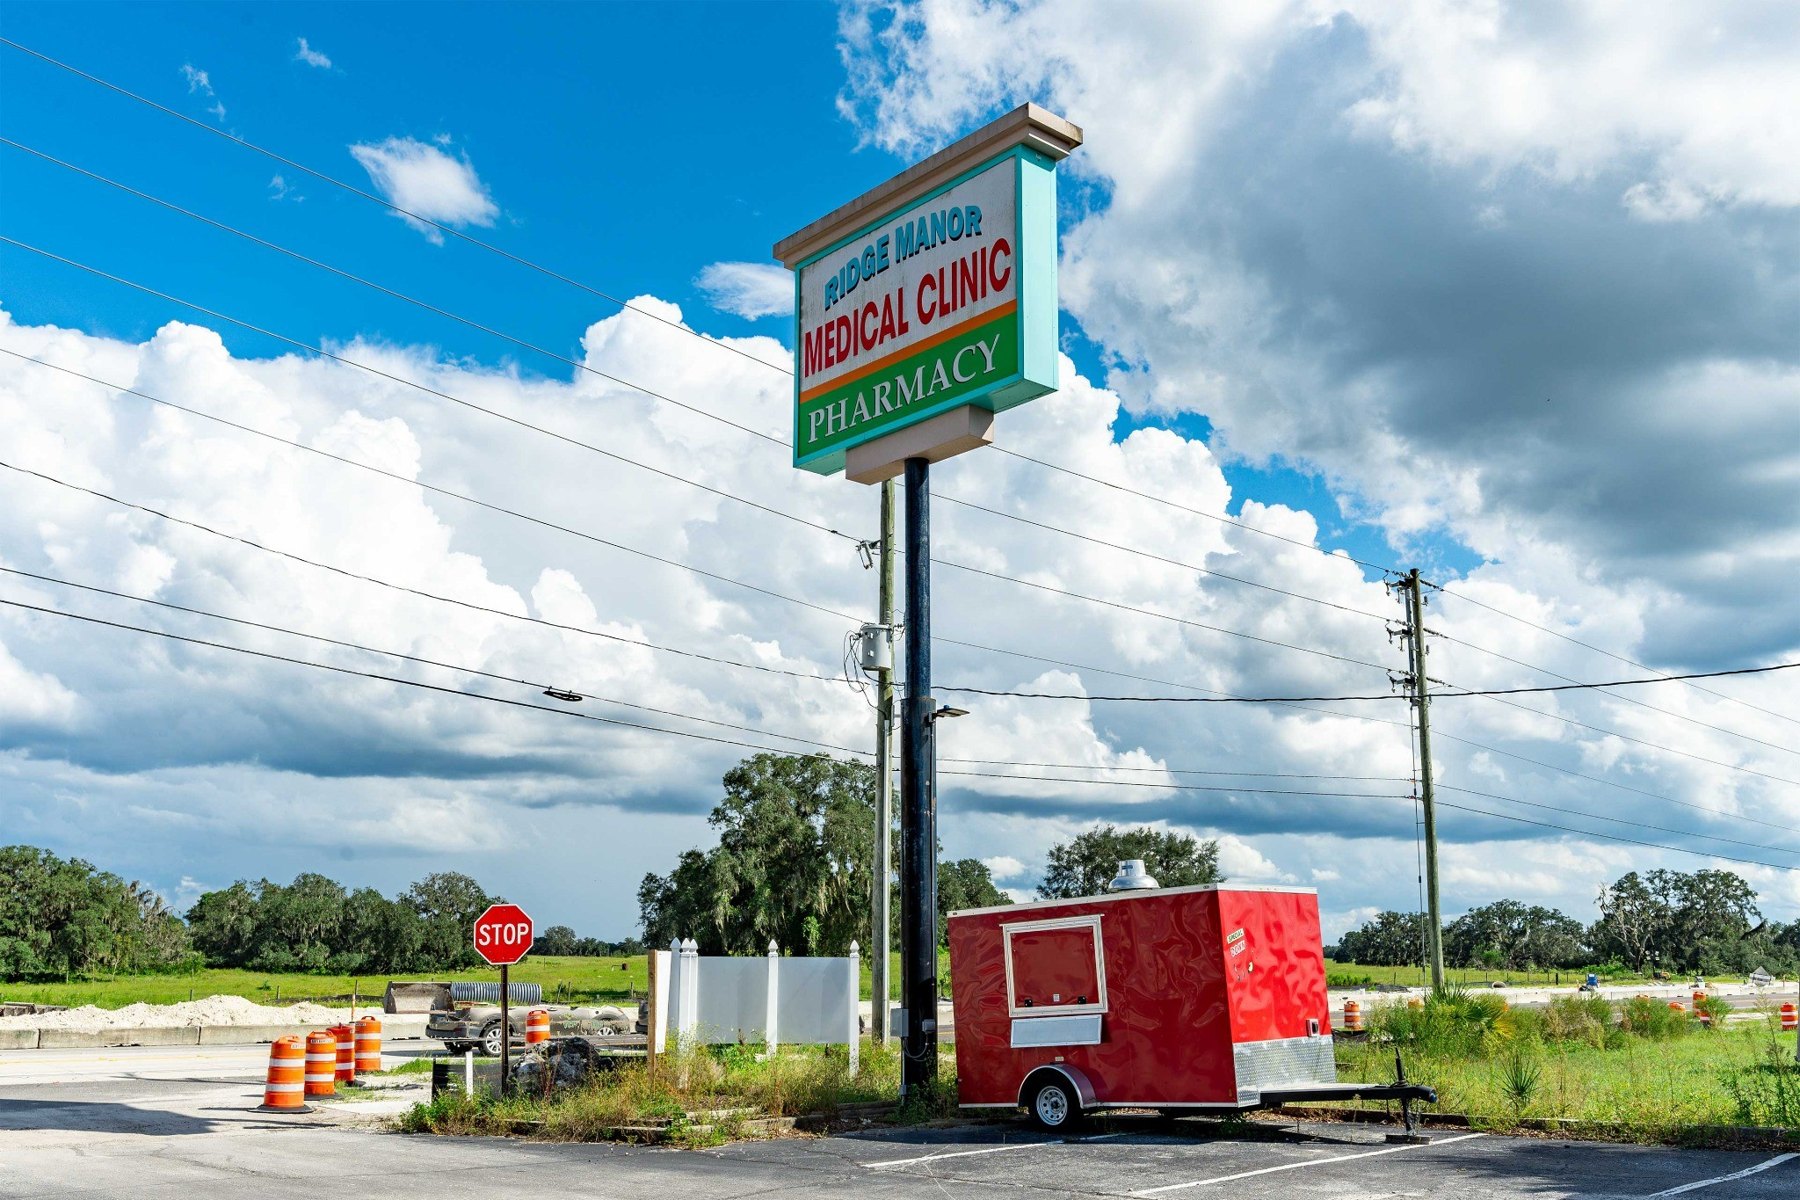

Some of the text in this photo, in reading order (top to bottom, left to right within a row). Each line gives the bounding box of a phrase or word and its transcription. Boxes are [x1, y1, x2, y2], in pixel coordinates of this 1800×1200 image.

[804, 237, 1012, 378] MEDICAL CLINIC
[825, 205, 983, 311] RIDGE MANOR
[808, 333, 1000, 443] PHARMACY
[478, 922, 529, 946] STOP
